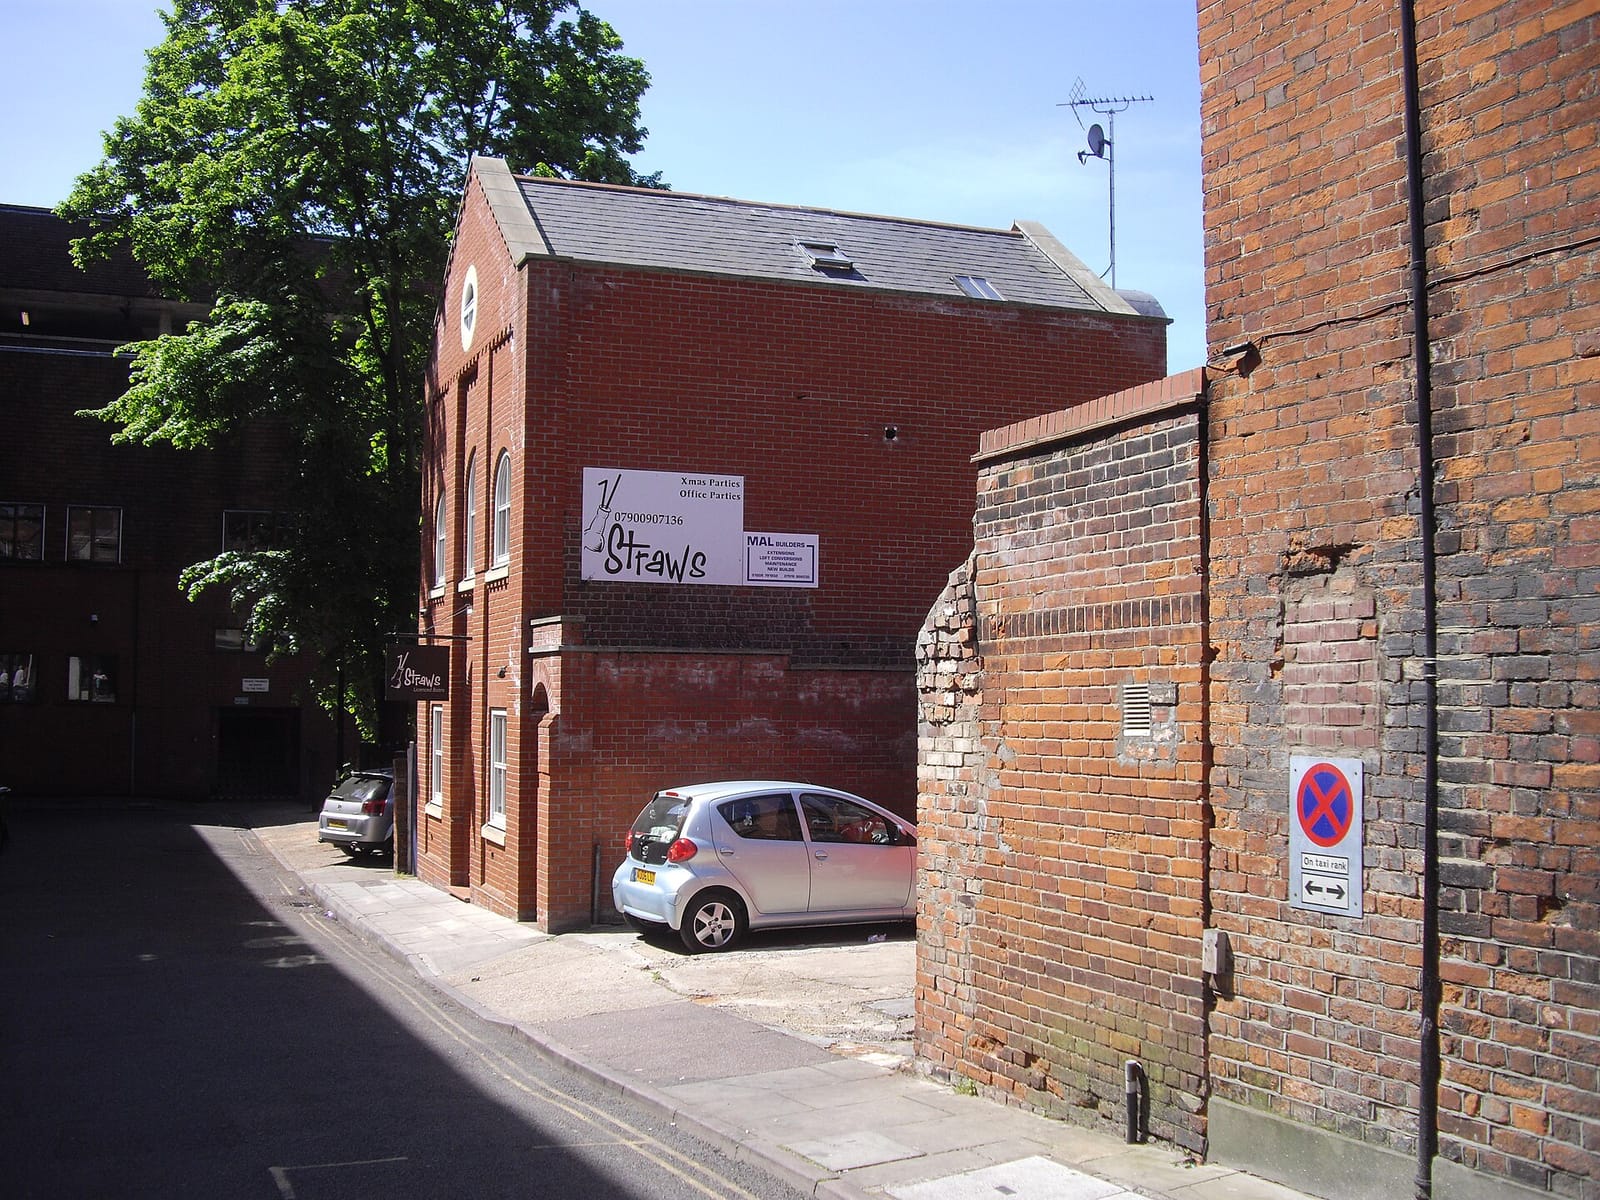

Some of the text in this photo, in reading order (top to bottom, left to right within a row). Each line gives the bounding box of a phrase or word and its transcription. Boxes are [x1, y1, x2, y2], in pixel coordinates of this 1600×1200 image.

[681, 477, 740, 488] Xmas Parties
[679, 490, 741, 500] Office Parties
[614, 512, 684, 525] 07900907136
[747, 536, 774, 547] MAL
[604, 523, 707, 583] Straws
[404, 667, 441, 688] Straws
[1303, 857, 1347, 871] On taxi rank
